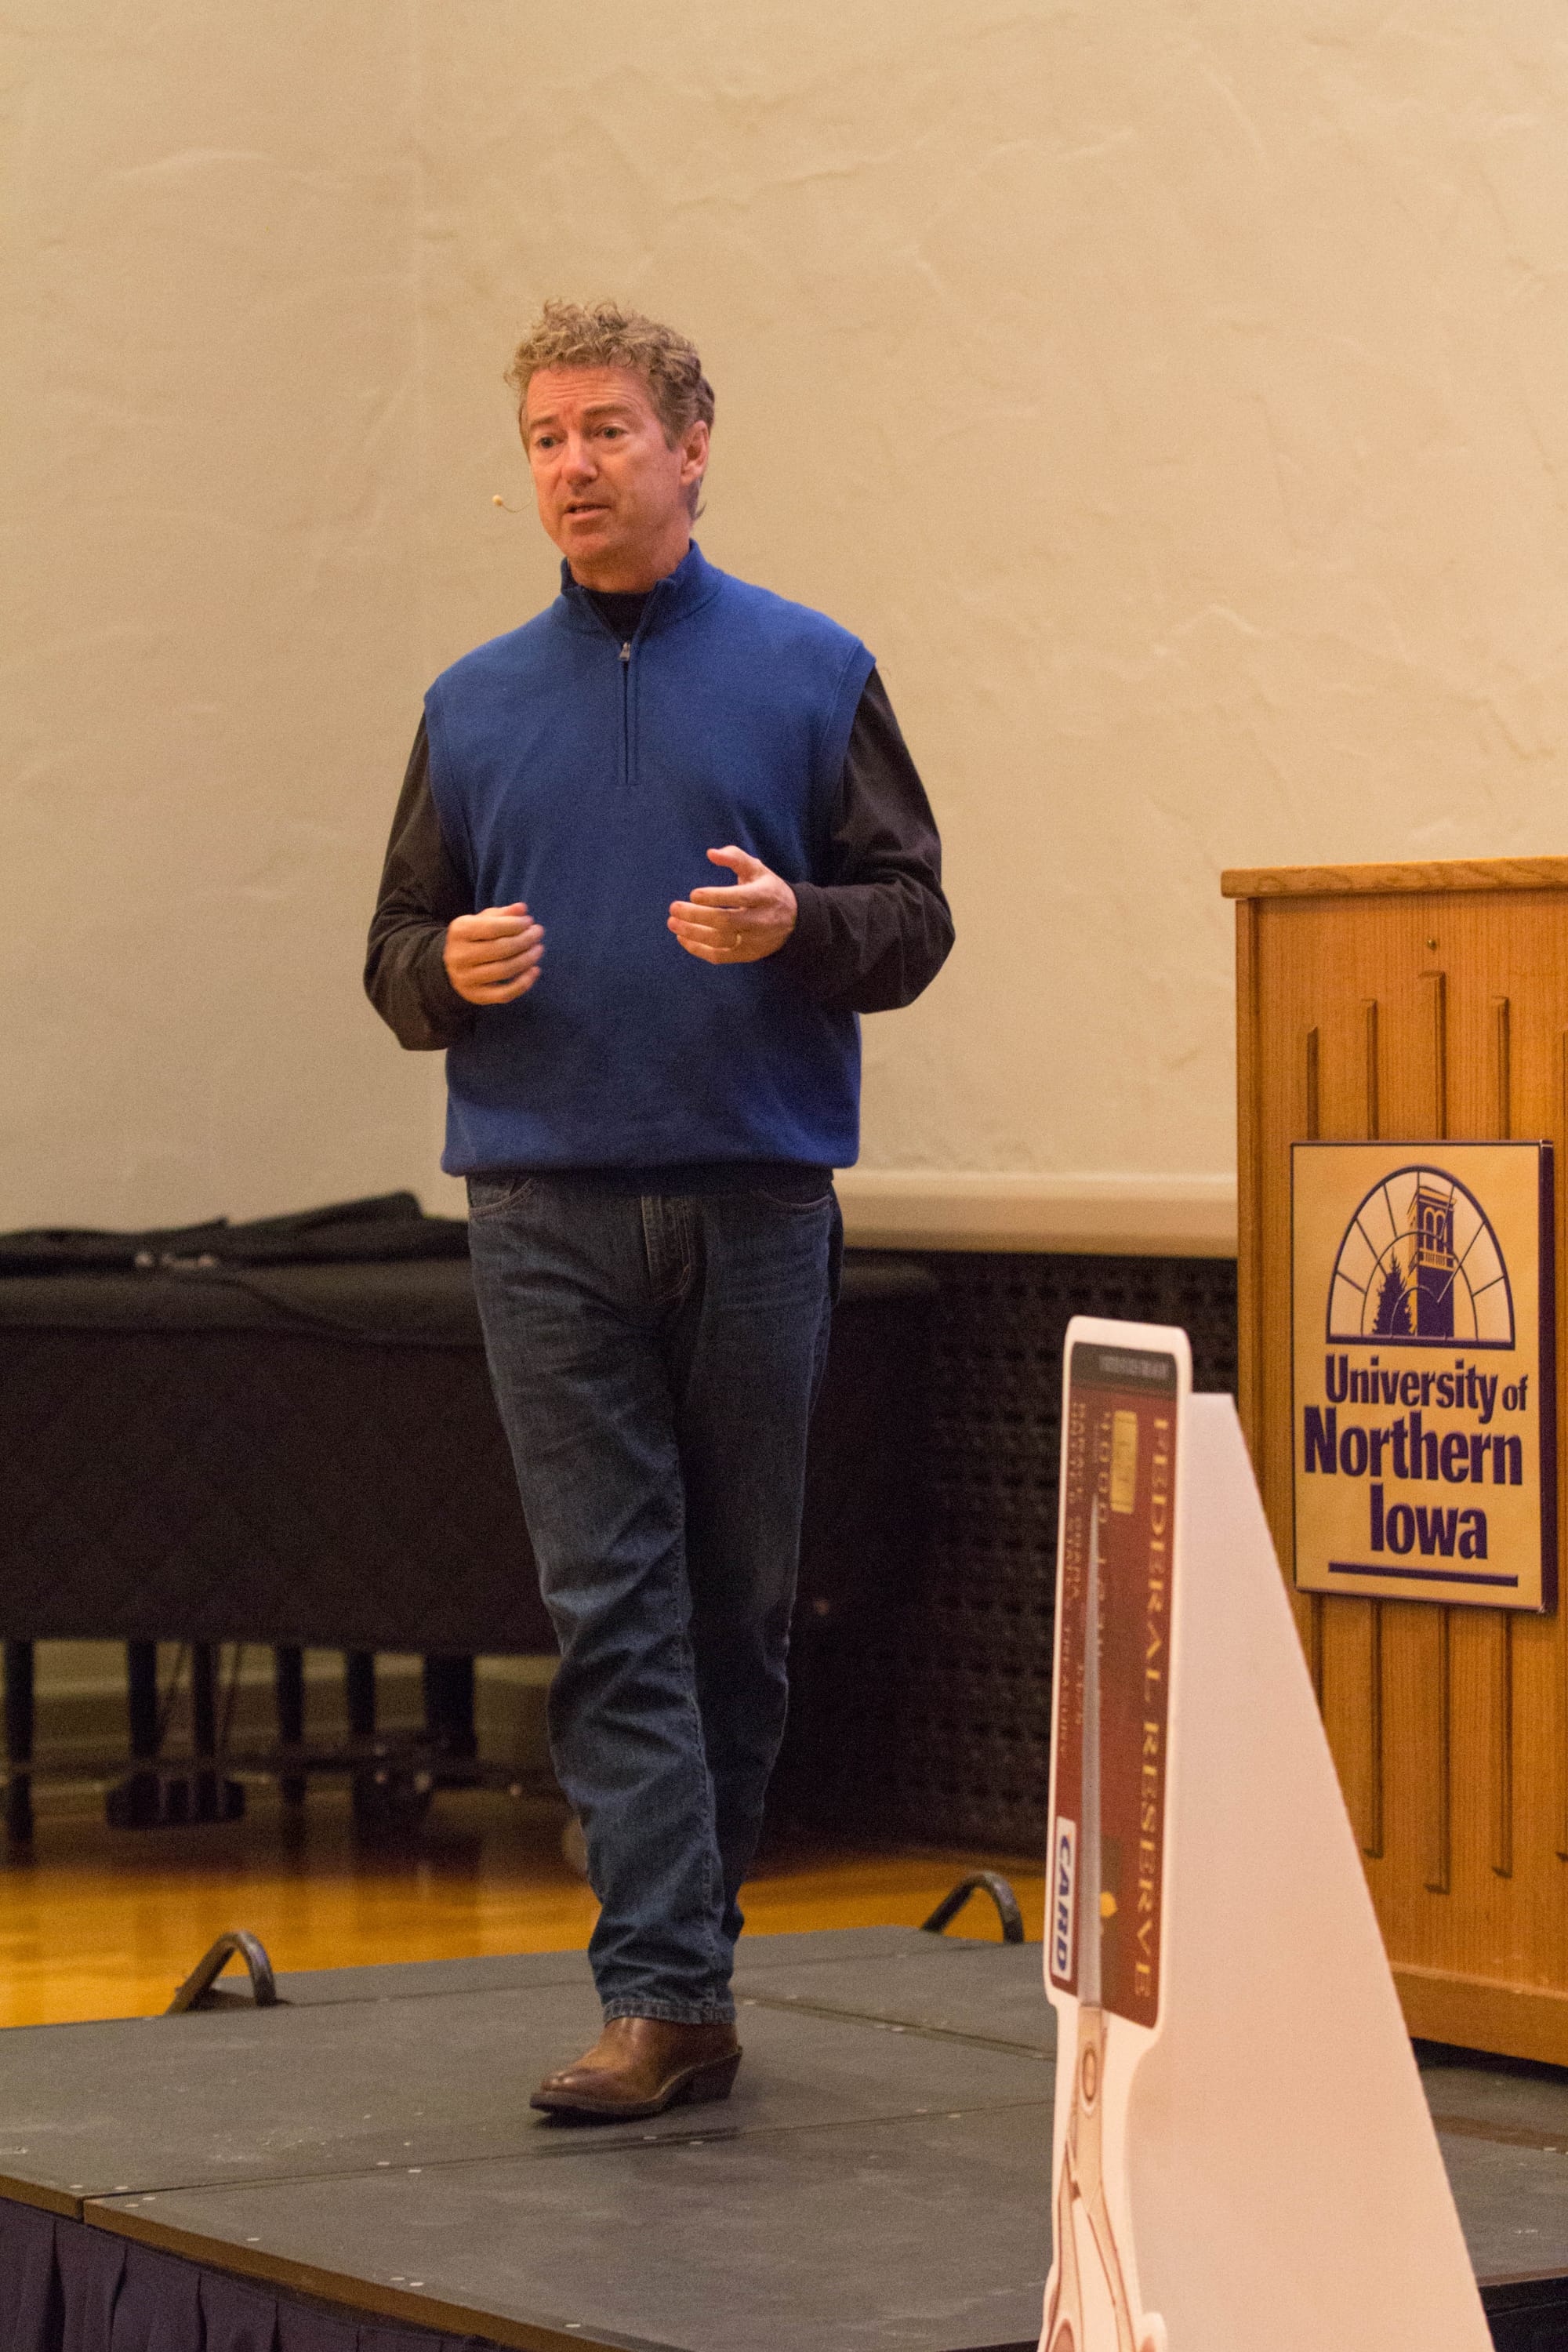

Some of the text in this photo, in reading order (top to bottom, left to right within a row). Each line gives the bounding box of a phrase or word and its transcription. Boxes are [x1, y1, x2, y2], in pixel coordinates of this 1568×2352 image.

[1325, 1352, 1530, 1425] University of
[1303, 1404, 1523, 1486] Northern
[1370, 1483, 1489, 1560] Iowa
[1134, 1417, 1170, 1997] FEDERAL RESERVE
[1056, 1835, 1072, 1972] CARD
